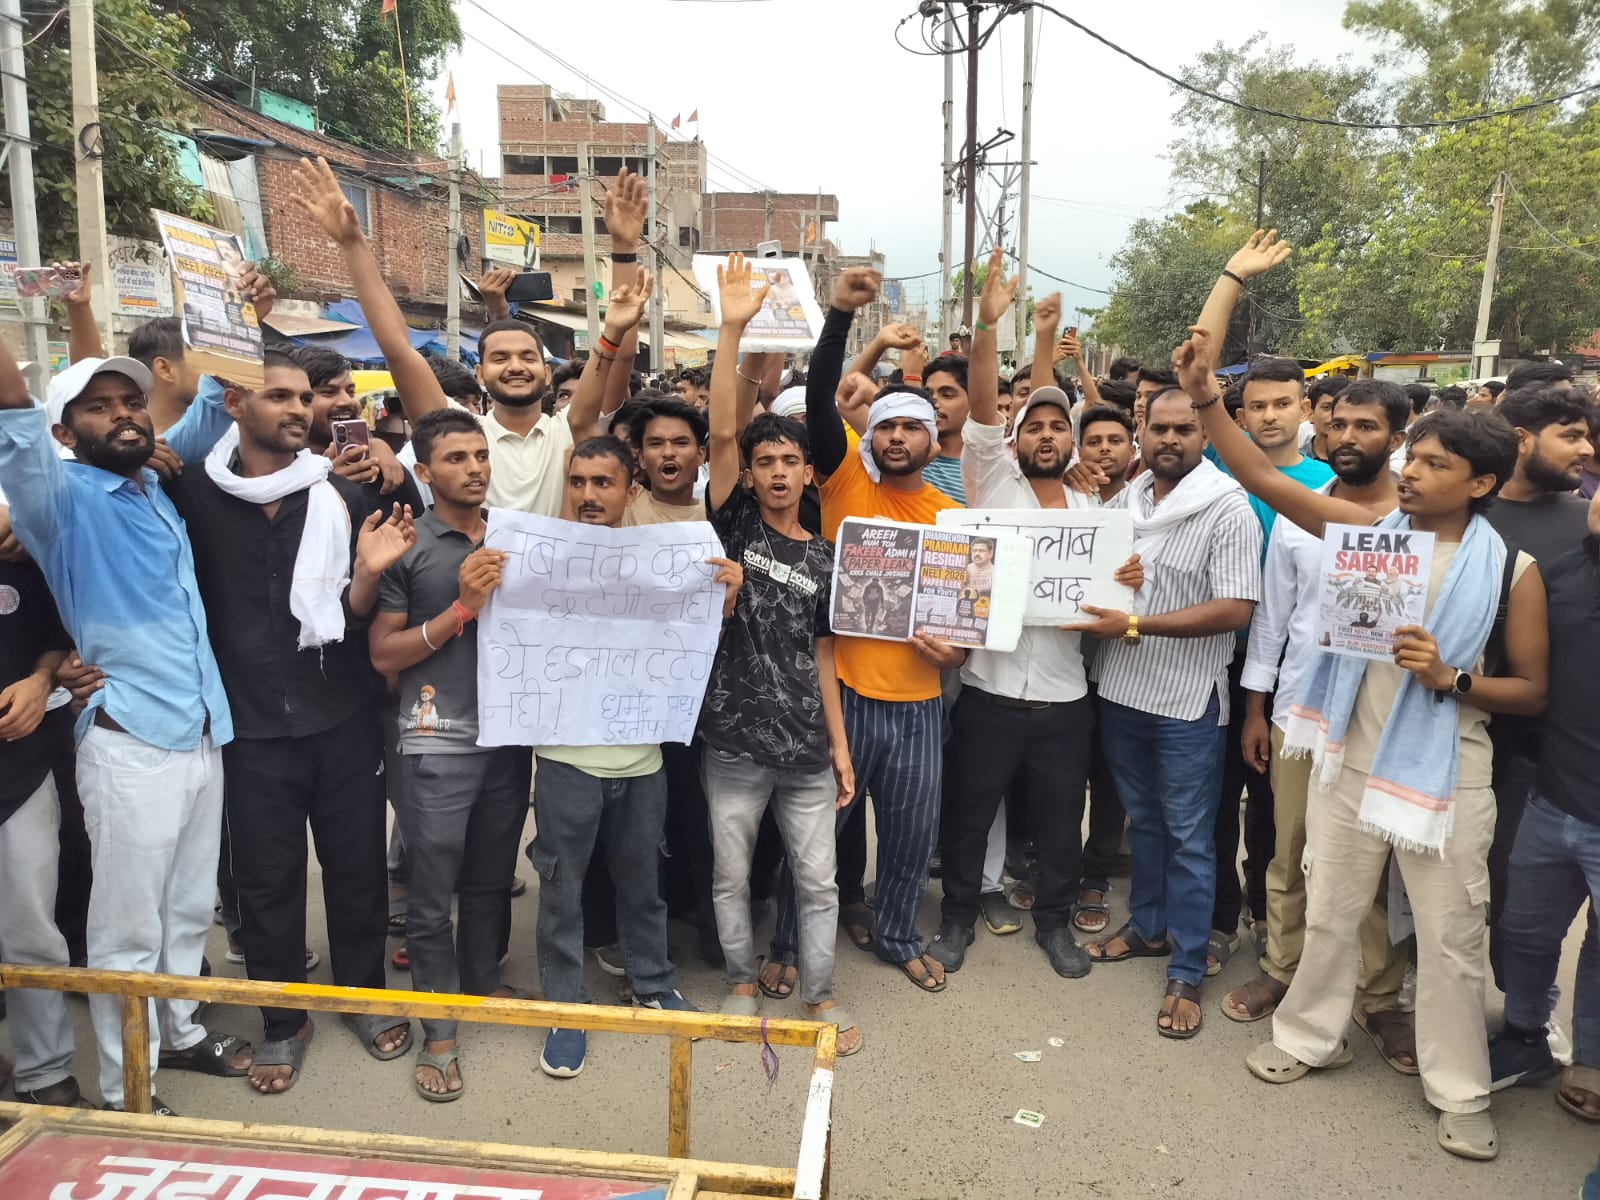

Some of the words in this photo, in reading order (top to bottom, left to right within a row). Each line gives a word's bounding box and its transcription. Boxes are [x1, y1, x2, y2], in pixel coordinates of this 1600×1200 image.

[488, 220, 515, 237] NITRO
[861, 528, 899, 541] AREEH
[924, 530, 970, 544] DHARMENDRA
[844, 543, 885, 557] FAKEER
[885, 547, 908, 558] ADMI
[909, 549, 917, 559] H
[923, 539, 970, 555] PRADHAAN
[1341, 532, 1413, 554] LEAK
[565, 541, 640, 583] तक
[848, 558, 881, 569] PAPER
[883, 558, 910, 570] LEAK
[924, 551, 967, 567] RESIGN!
[1335, 551, 1419, 576] SARKAR
[922, 567, 942, 579] NEET
[944, 570, 965, 581] 2026
[922, 578, 944, 588] PAPER
[922, 587, 936, 595] FOR
[937, 588, 957, 598] YOUTH
